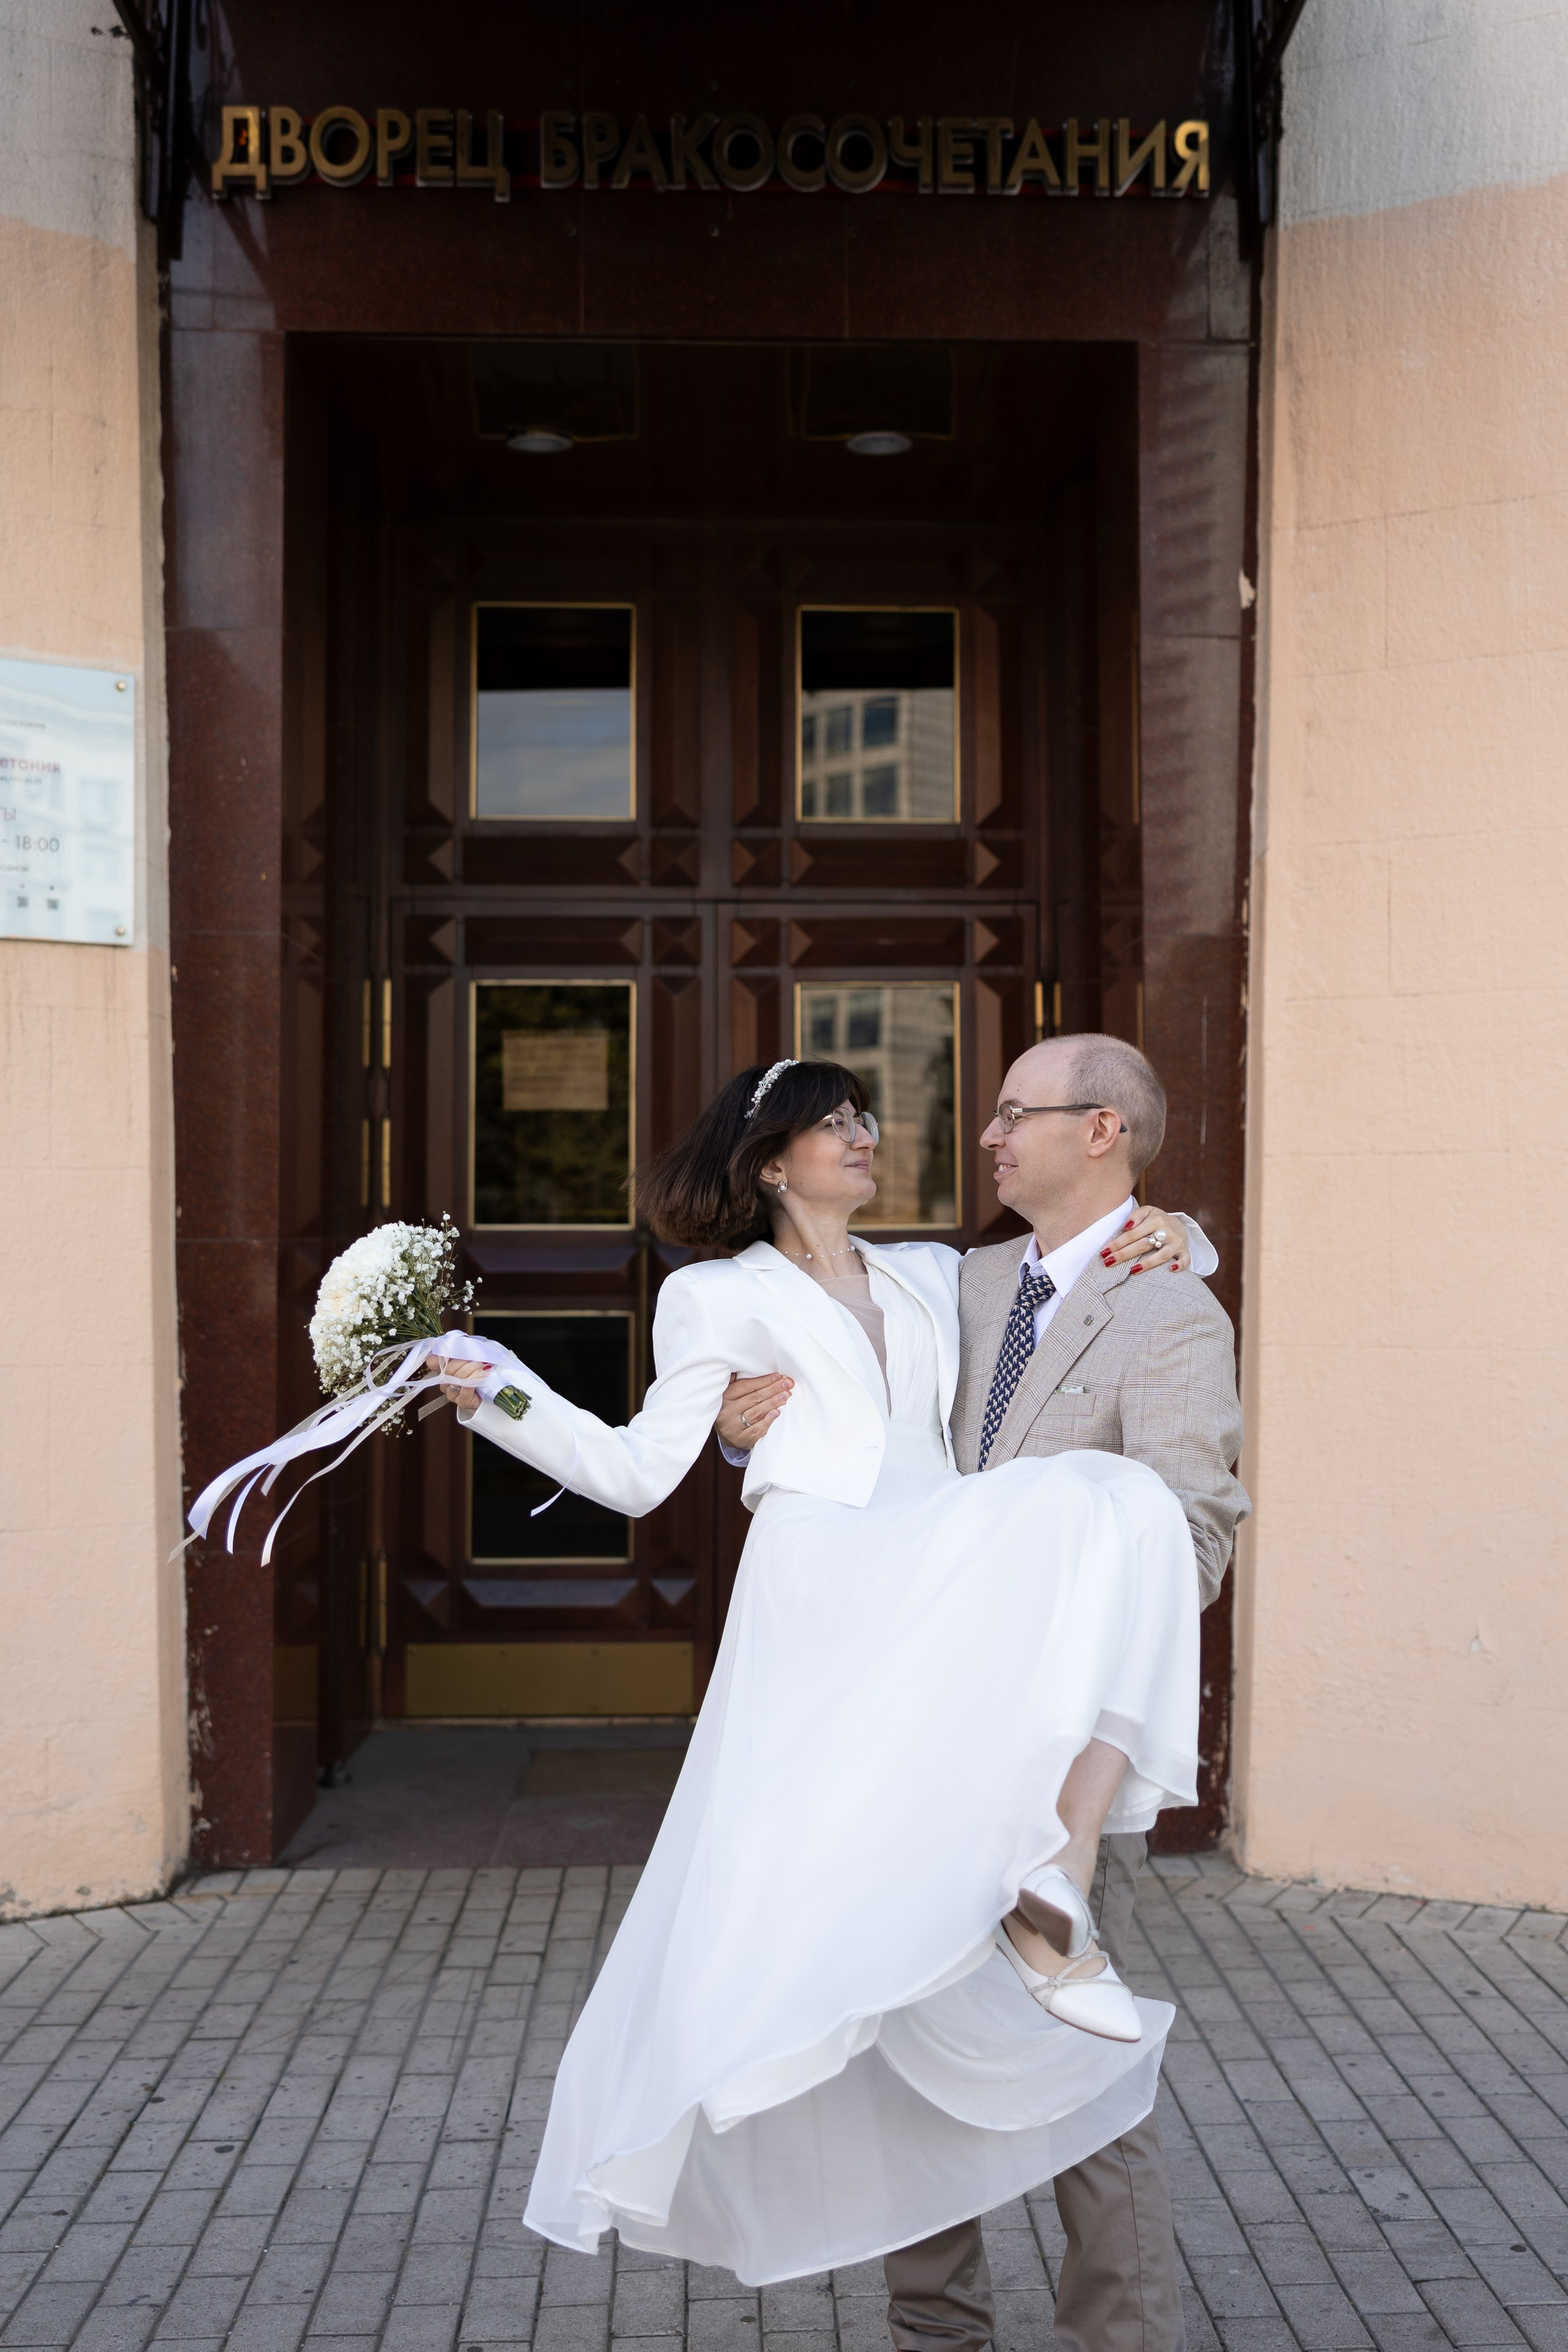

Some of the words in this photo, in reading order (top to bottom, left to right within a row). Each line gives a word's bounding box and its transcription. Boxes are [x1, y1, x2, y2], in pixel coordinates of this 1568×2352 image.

[212, 105, 510, 202] ДВОРЕЦ
[540, 111, 1210, 198] БРАКОСОЧЕТАНИЯ
[15, 834, 60, 853] 18:00
